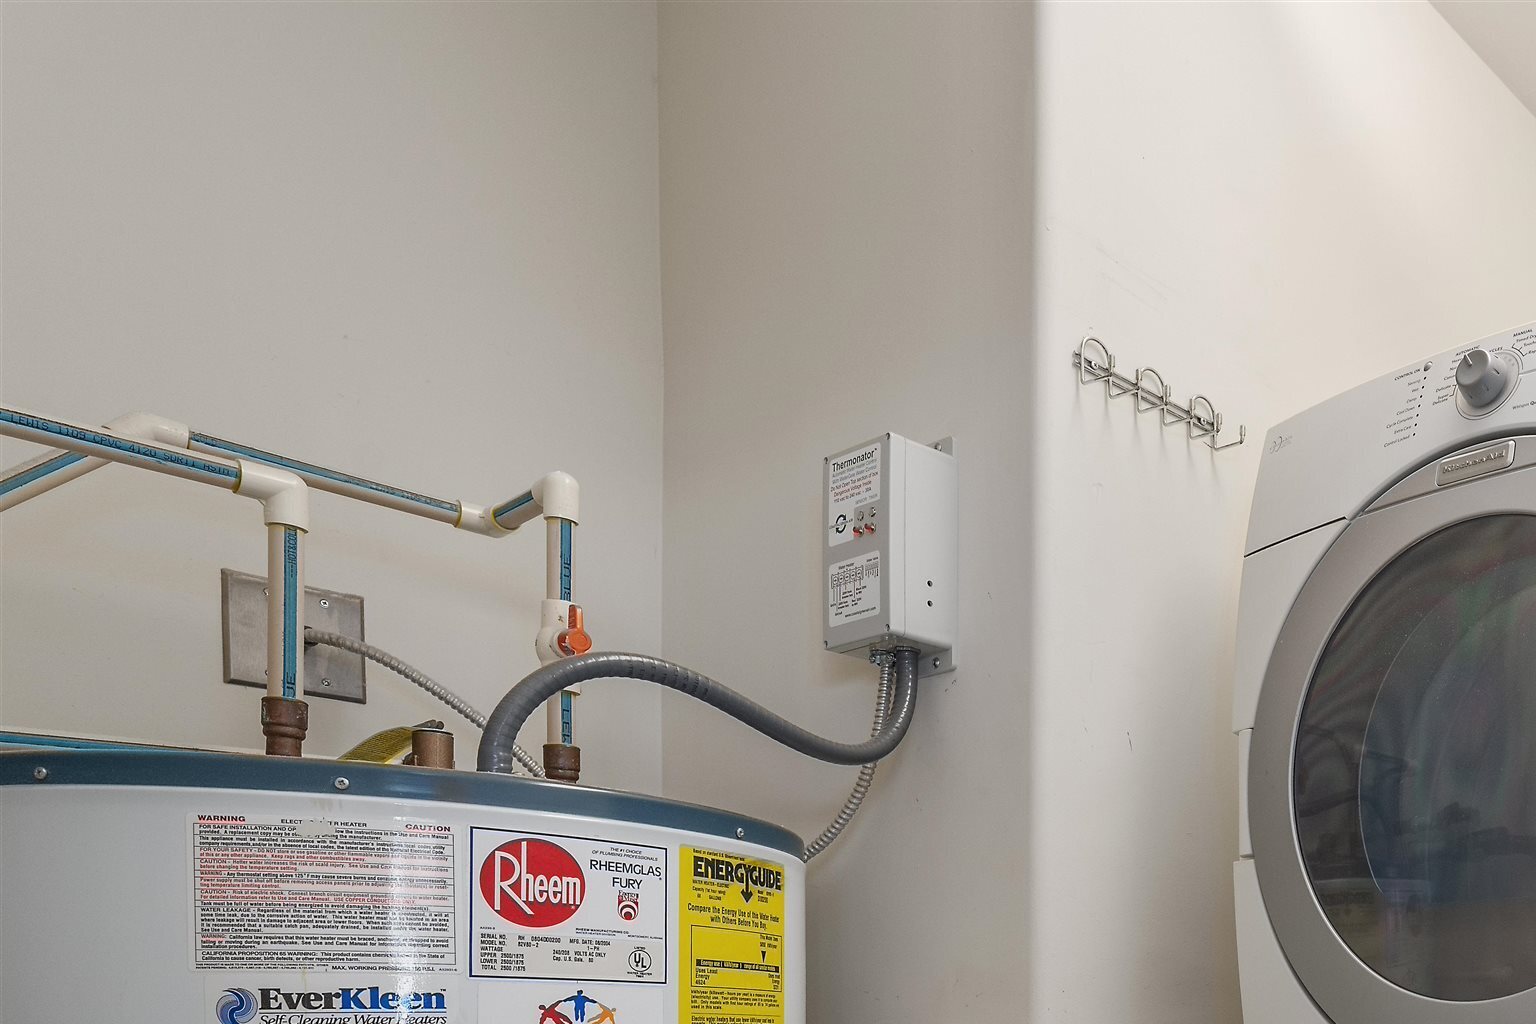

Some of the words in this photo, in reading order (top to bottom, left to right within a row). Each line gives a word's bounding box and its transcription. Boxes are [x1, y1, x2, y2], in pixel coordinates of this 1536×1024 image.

[11, 414, 49, 430] LEWIS
[93, 435, 123, 450] CPVC
[129, 444, 157, 458] 4120
[832, 450, 874, 472] Thermonator
[624, 853, 658, 861] PROFESSIONALS
[590, 859, 662, 877] RHEEMGLAS
[693, 856, 782, 890] ENERGYGUIDE
[494, 841, 580, 915] Rheem
[612, 877, 642, 889] FURY
[688, 903, 711, 913] Compare
[722, 907, 737, 917] Energy
[722, 916, 736, 924] Others
[738, 917, 751, 926] Before
